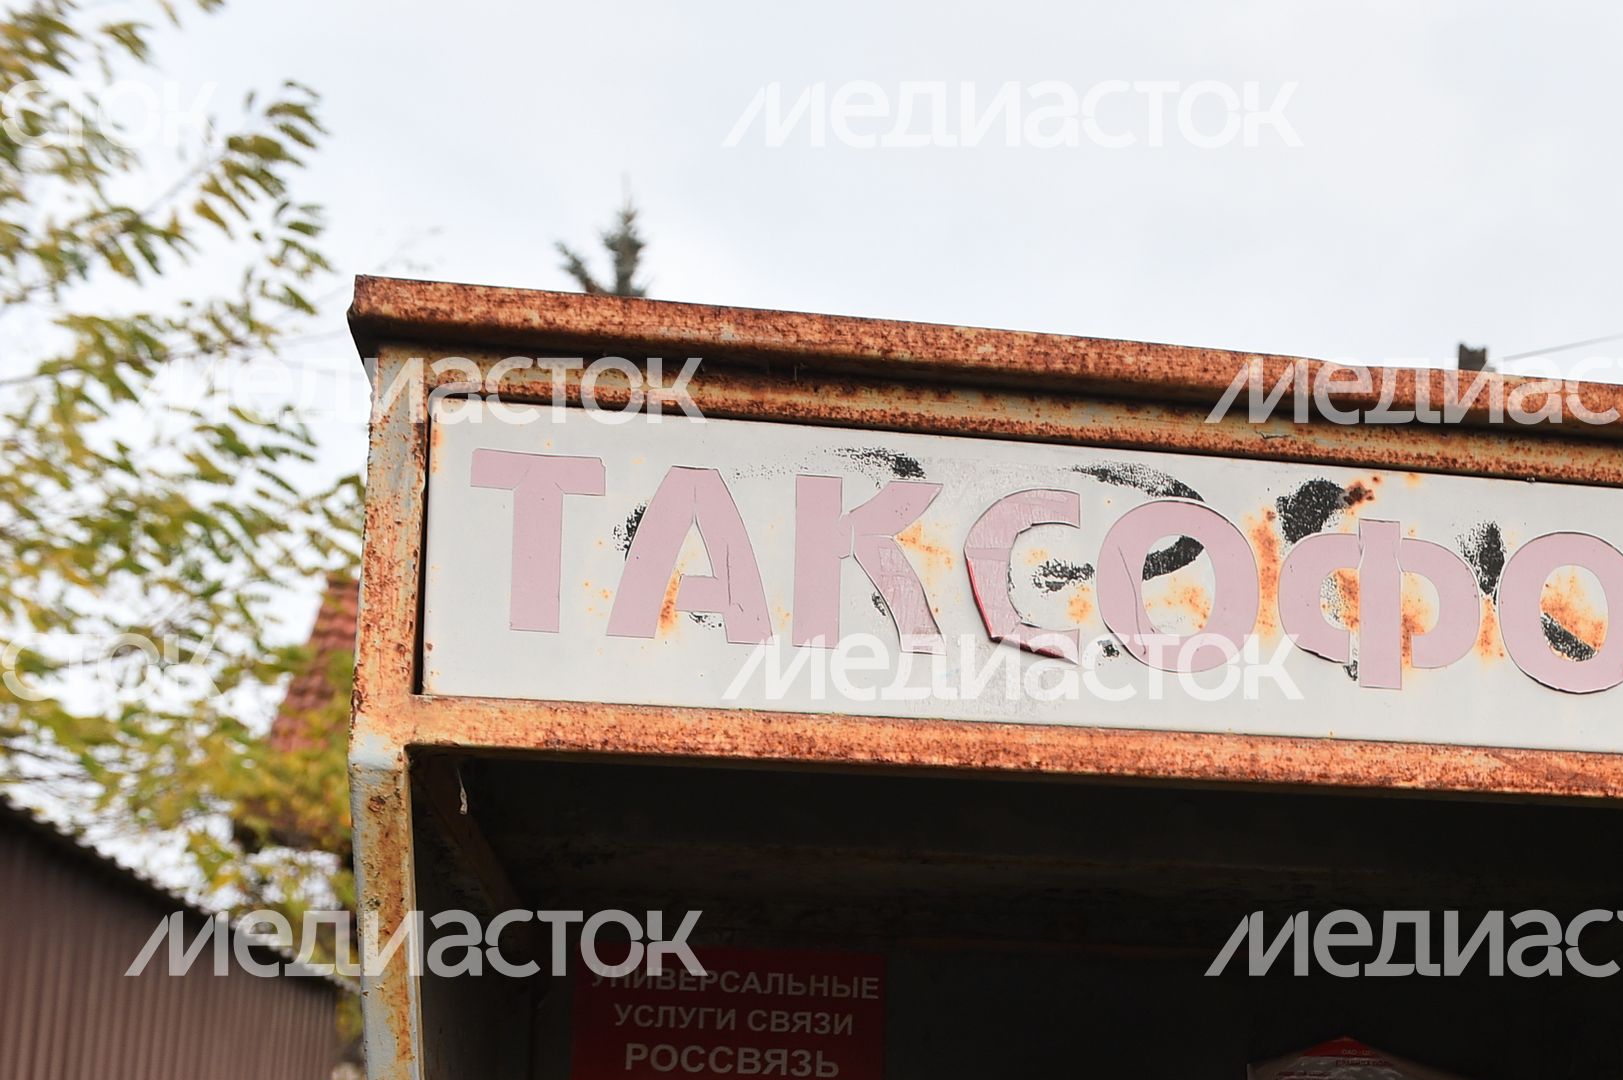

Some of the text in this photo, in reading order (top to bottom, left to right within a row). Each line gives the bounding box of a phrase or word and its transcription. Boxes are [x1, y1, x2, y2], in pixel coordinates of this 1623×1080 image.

[613, 1002, 854, 1037] УСЛУГИ СВЯЗИ
[624, 1042, 841, 1079] РОССВЯЗЬ
